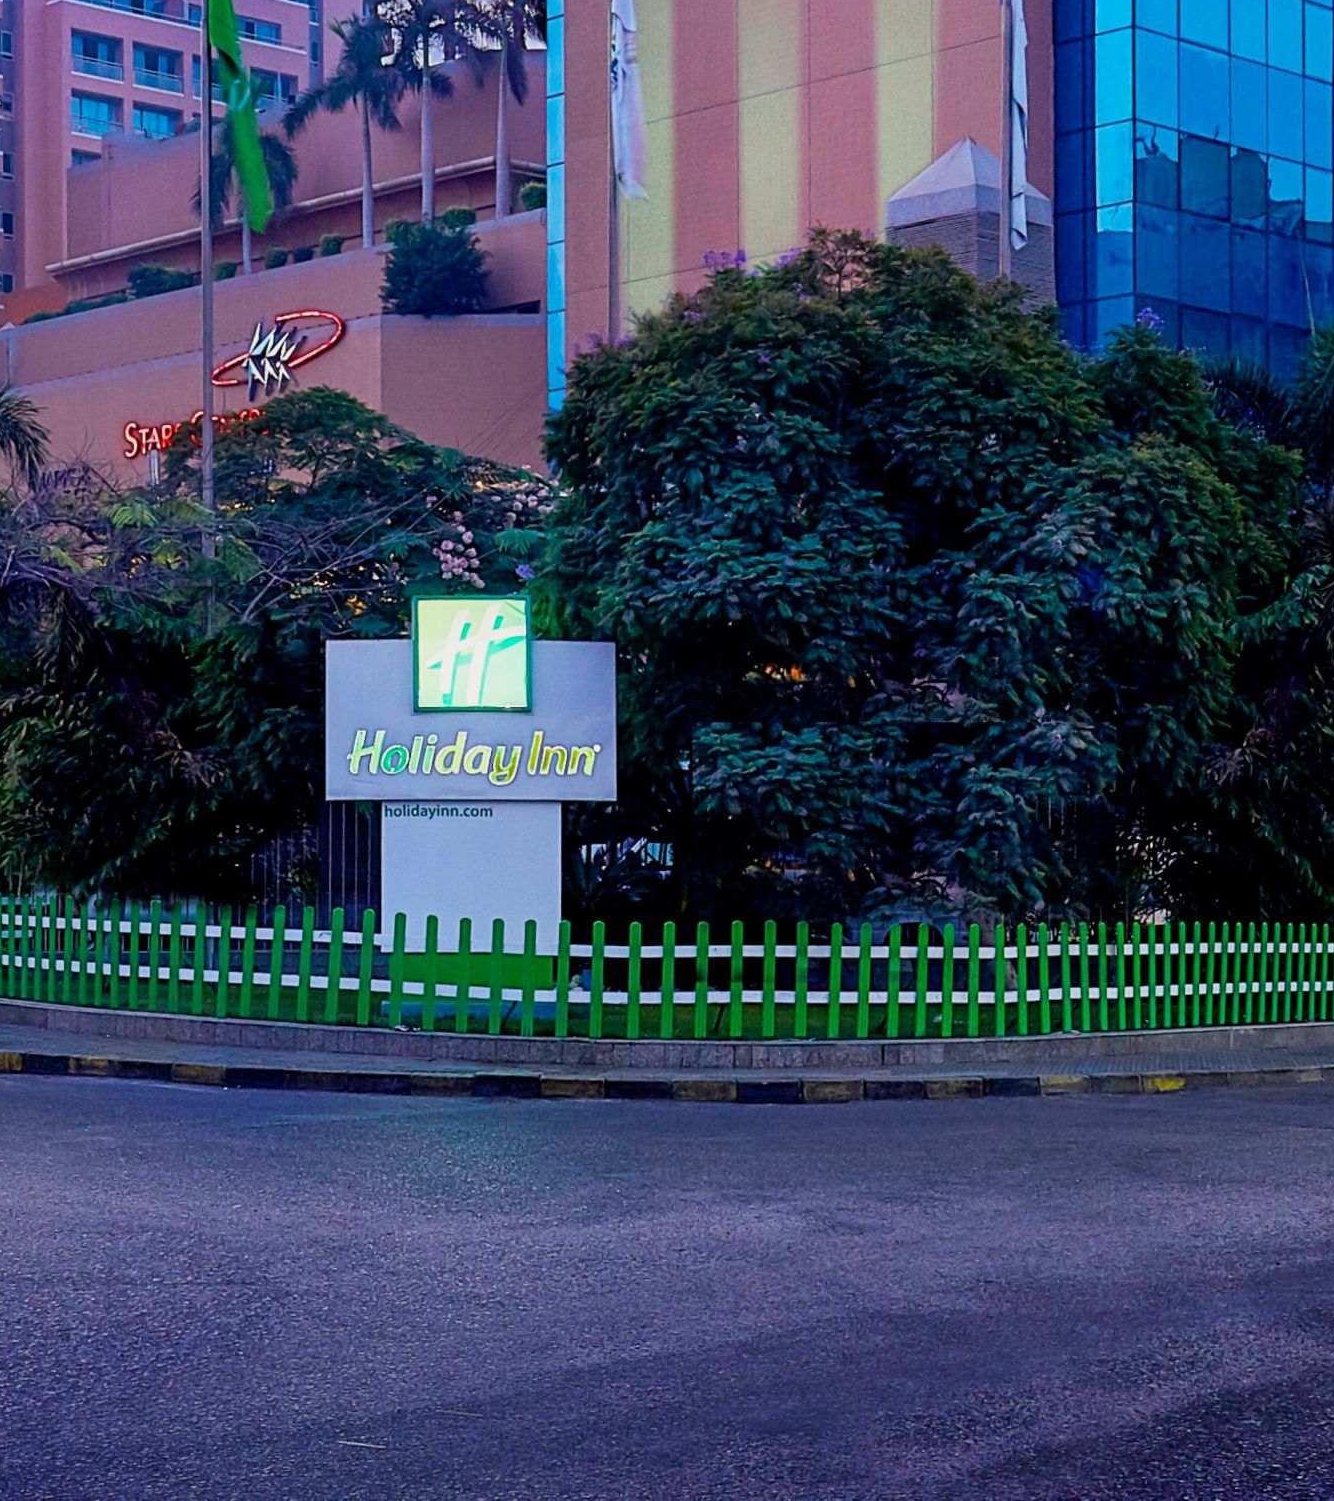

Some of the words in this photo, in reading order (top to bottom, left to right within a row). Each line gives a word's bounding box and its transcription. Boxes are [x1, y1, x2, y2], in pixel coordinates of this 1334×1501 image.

[346, 729, 523, 787] Holiday
[527, 730, 597, 777] Inn
[384, 804, 494, 819] holidayinn.com
